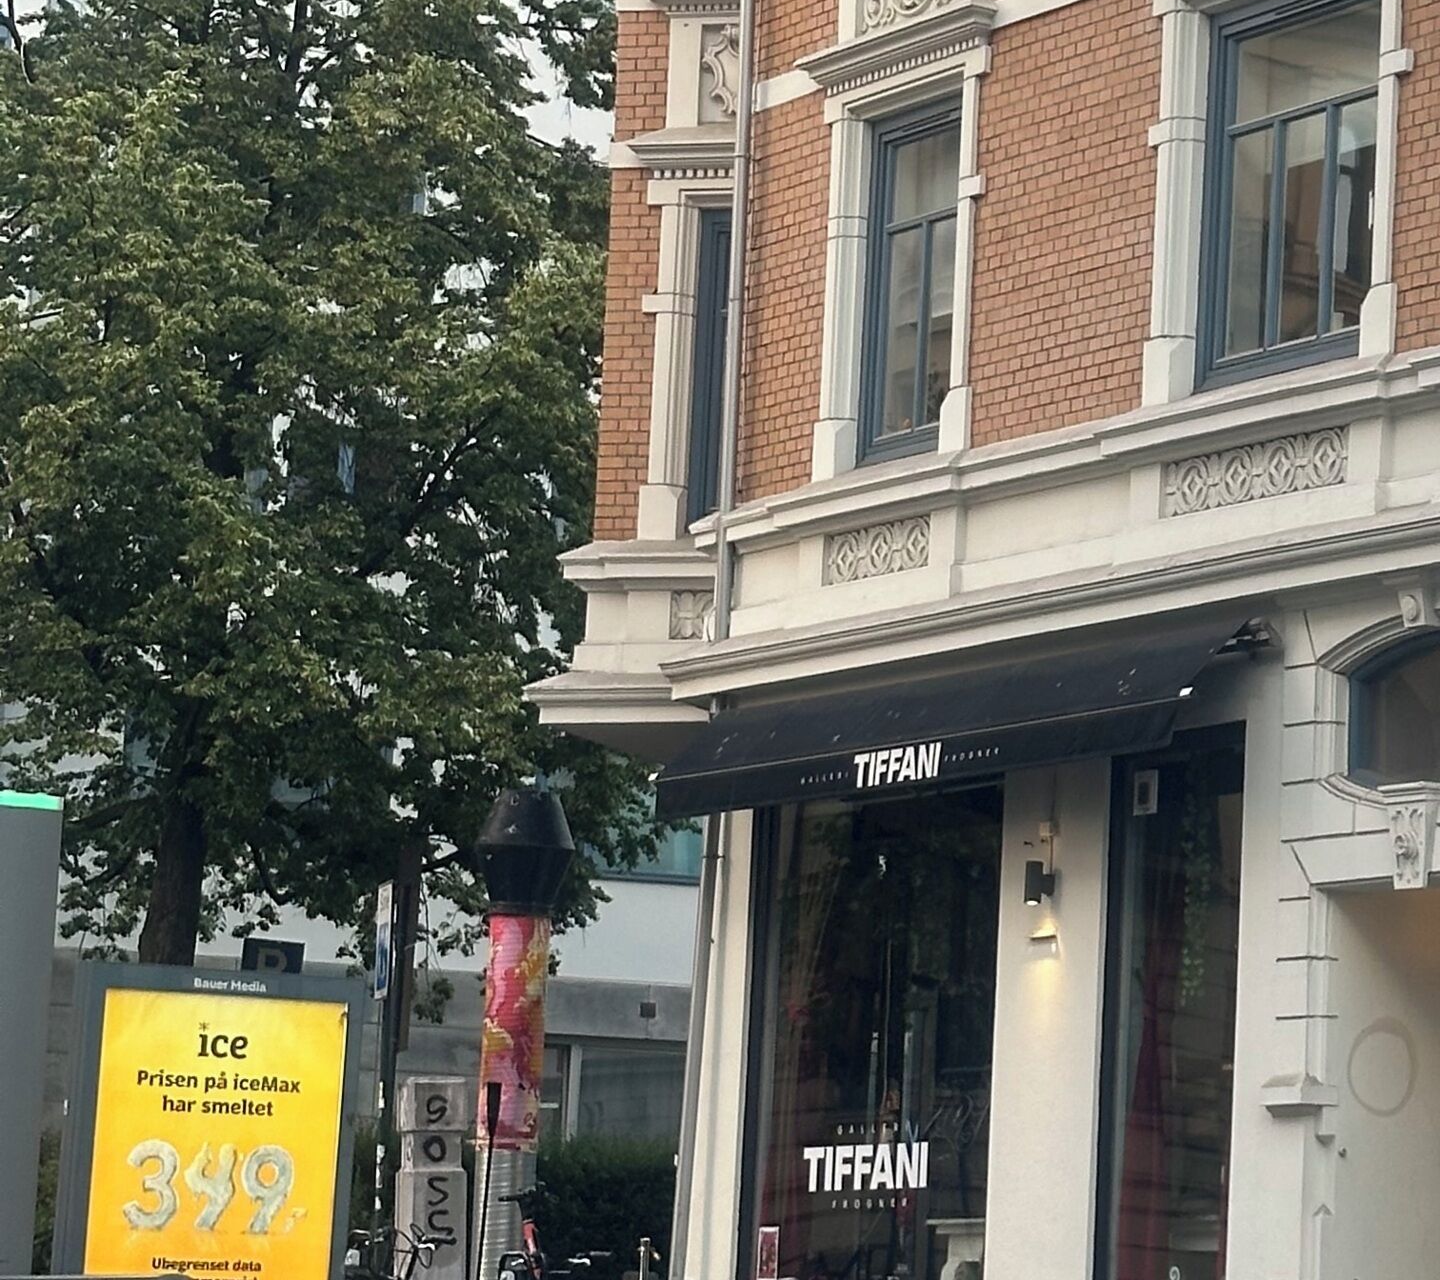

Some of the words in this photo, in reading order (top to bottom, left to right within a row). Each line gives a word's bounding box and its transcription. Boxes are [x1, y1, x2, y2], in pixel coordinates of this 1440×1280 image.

[854, 742, 942, 789] TIFFANI
[194, 977, 228, 991] Bauer
[231, 979, 267, 993] Media
[197, 1022, 249, 1059] ice
[136, 1070, 198, 1088] Prisen
[204, 1070, 228, 1094] på
[233, 1073, 301, 1093] iceMax
[161, 1095, 196, 1113] har
[201, 1098, 274, 1117] smeltet
[837, 1121, 909, 1136] GALLER
[803, 1141, 930, 1193] TIFFANI
[152, 1257, 229, 1274] Ubegrenset
[232, 1259, 263, 1273] data
